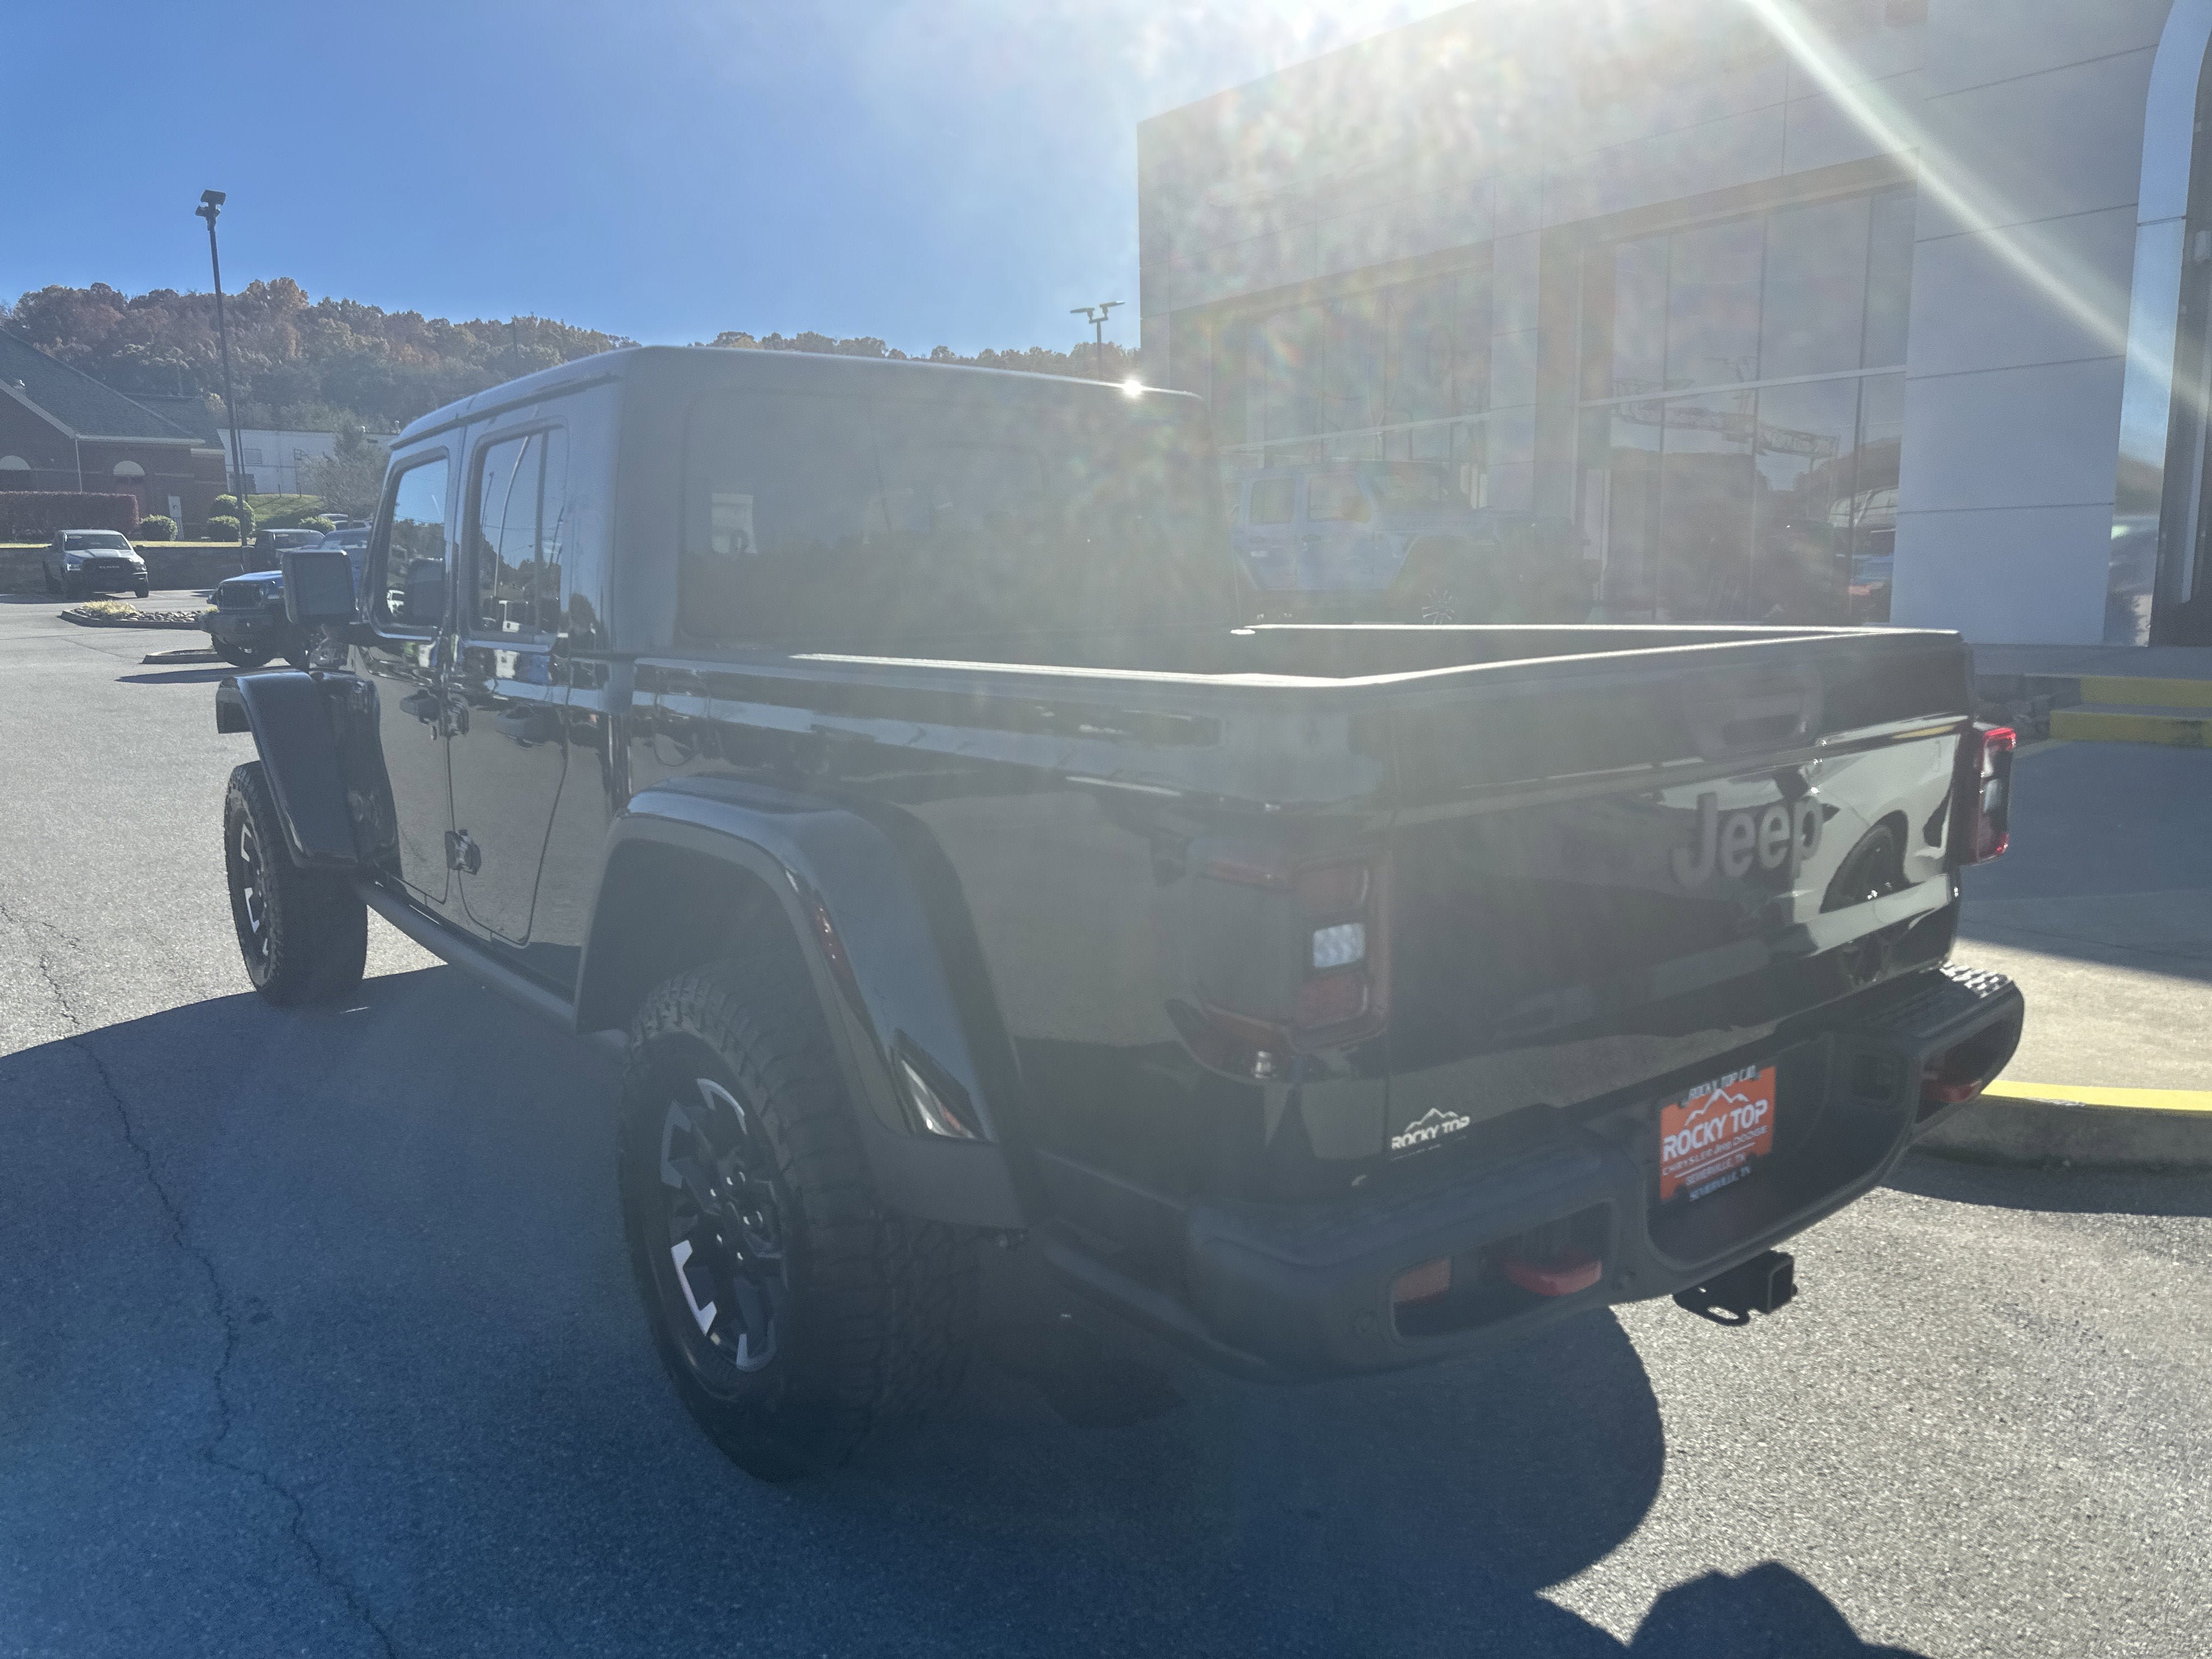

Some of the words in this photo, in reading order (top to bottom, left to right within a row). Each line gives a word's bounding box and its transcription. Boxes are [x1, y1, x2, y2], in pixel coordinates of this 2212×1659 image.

[1672, 792, 1824, 887] Jeep
[1391, 1124, 1440, 1150] ROCKY
[1441, 1115, 1470, 1133] TOP
[1663, 1114, 1728, 1162] ROCKY
[1730, 1099, 1768, 1132] TOP
[1662, 1148, 1712, 1176] CHRYSLER
